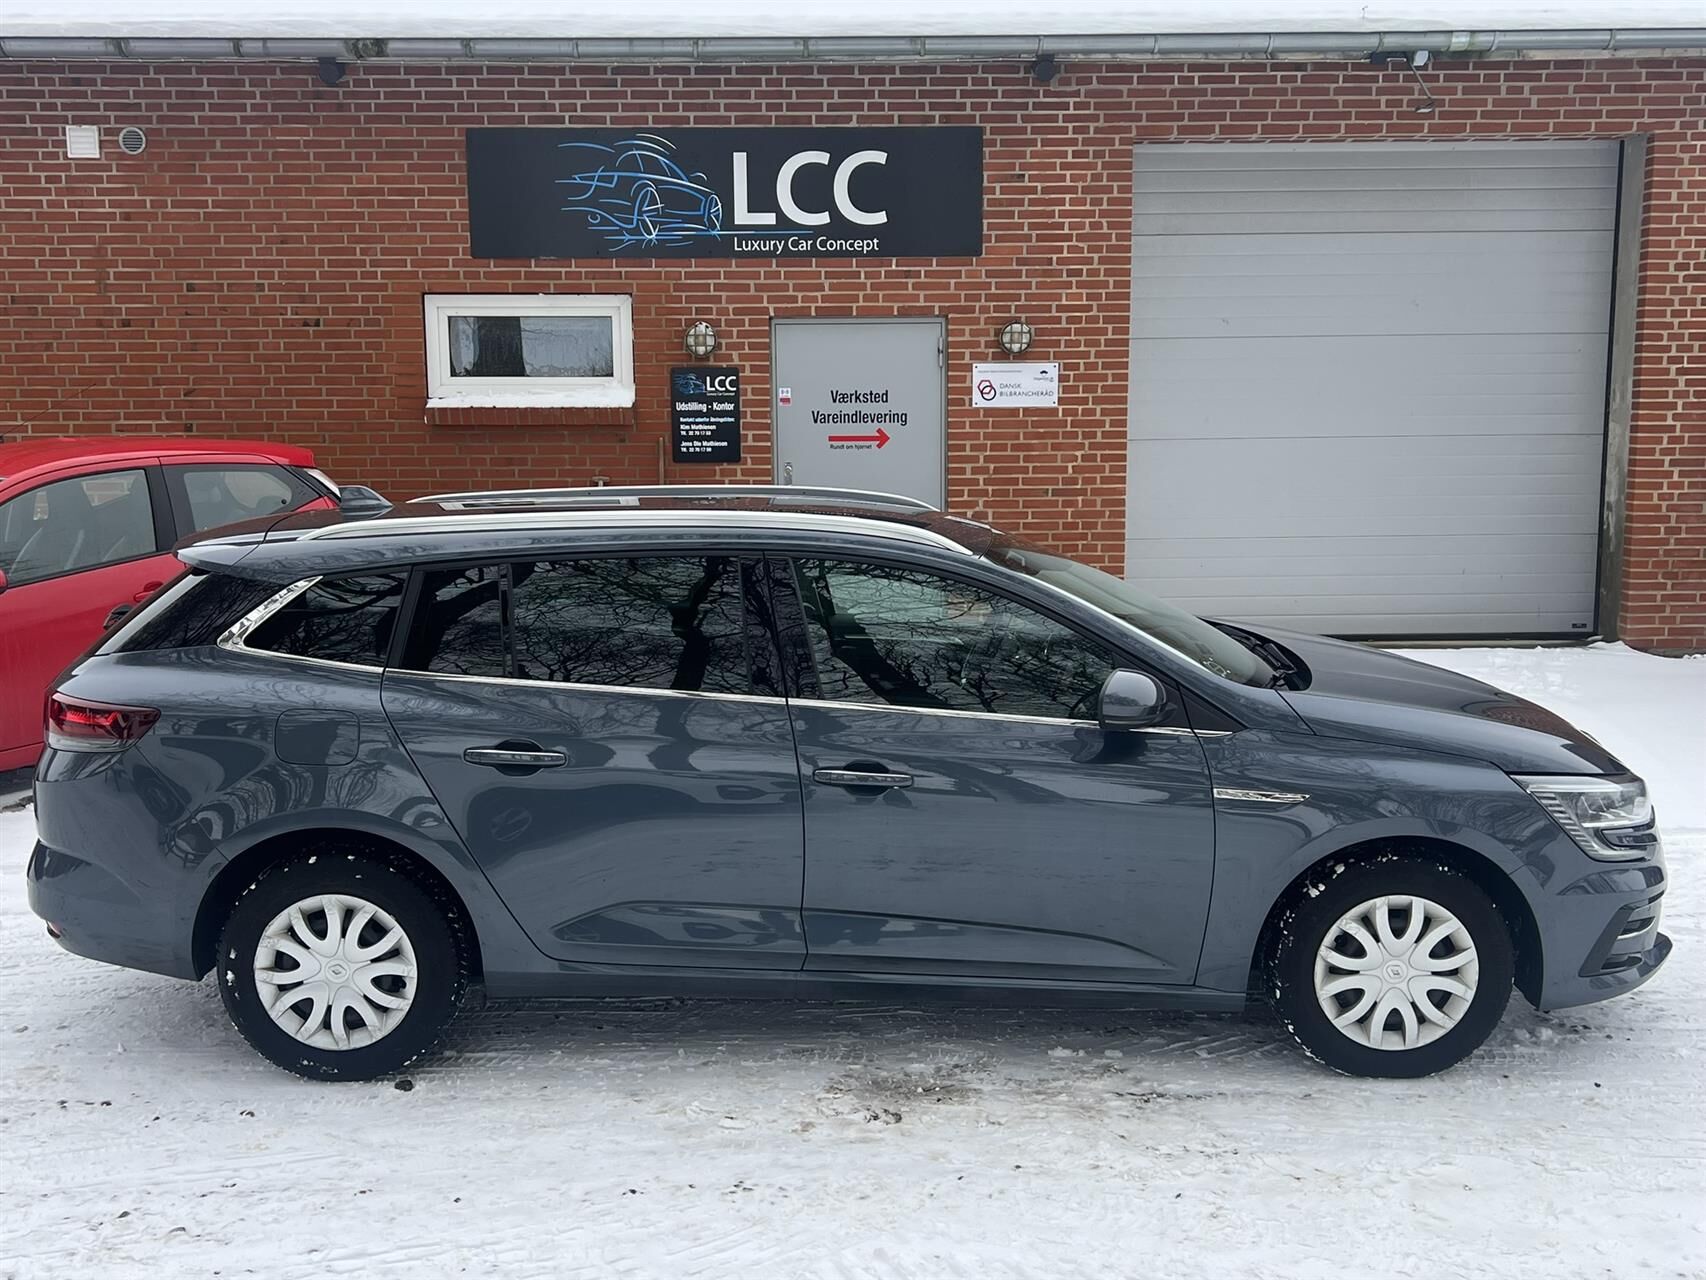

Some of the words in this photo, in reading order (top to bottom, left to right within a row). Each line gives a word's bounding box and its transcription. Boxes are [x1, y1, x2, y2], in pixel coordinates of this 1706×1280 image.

[732, 150, 888, 226] LCC
[734, 236, 785, 254] Luxury
[788, 236, 813, 251] Car
[816, 236, 879, 254] Concept
[706, 376, 737, 391] LCC
[830, 389, 889, 404] Værksted
[675, 402, 707, 412] Udstilling
[712, 402, 735, 411] Kontor
[811, 409, 908, 426] Vareindlevering
